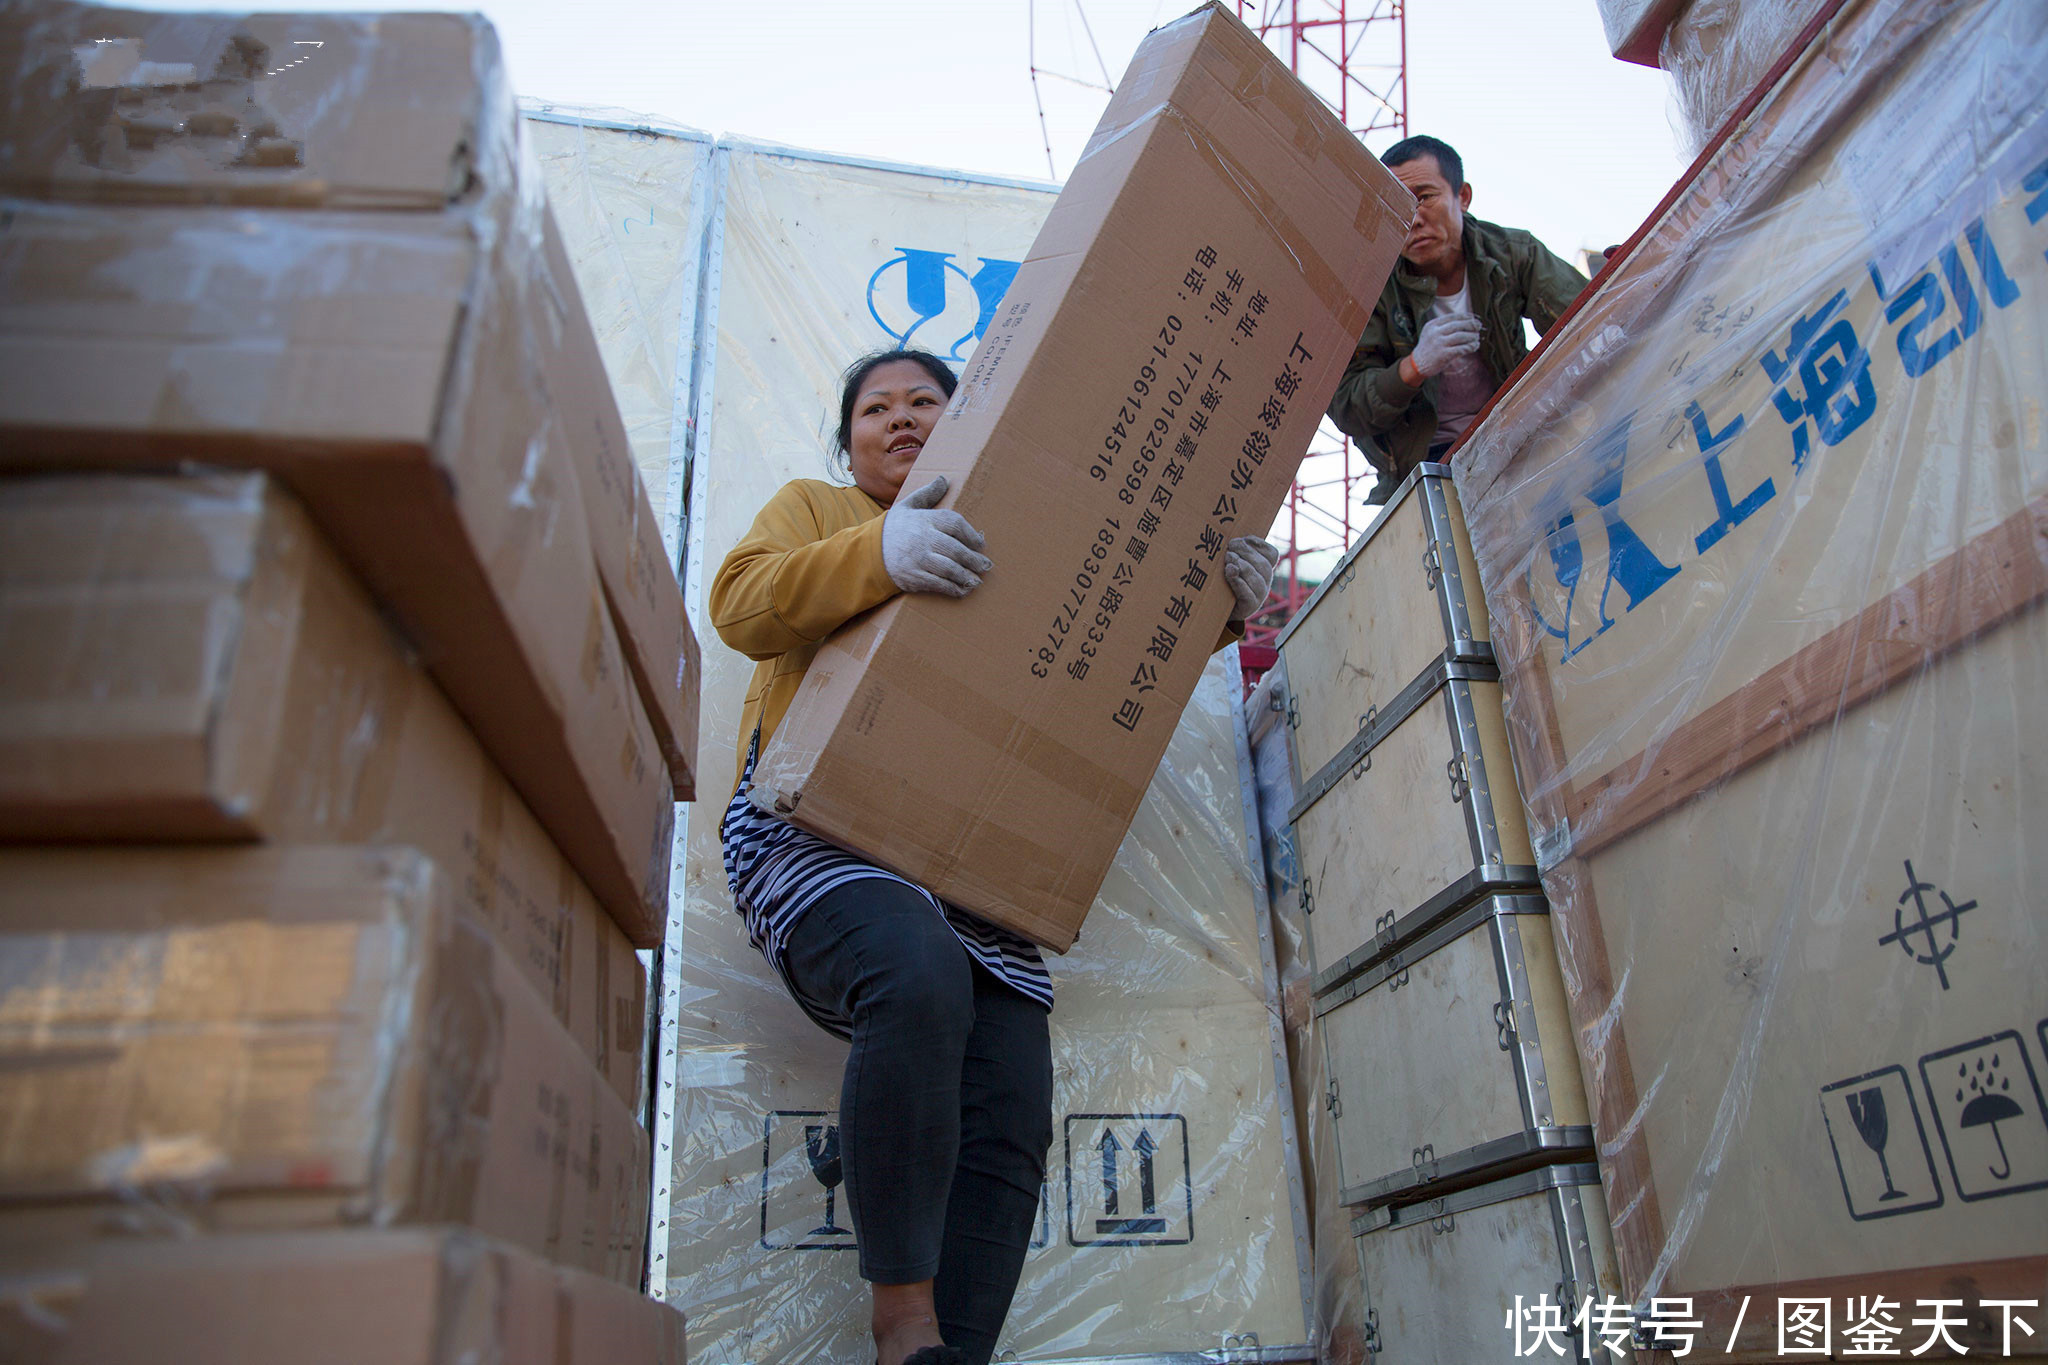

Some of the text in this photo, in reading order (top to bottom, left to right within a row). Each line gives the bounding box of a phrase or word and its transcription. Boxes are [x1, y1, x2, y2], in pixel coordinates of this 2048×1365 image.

[1116, 351, 1203, 505] 17701629598
[1684, 157, 2048, 556] 上海凯
[1030, 517, 1121, 679] 18930772783
